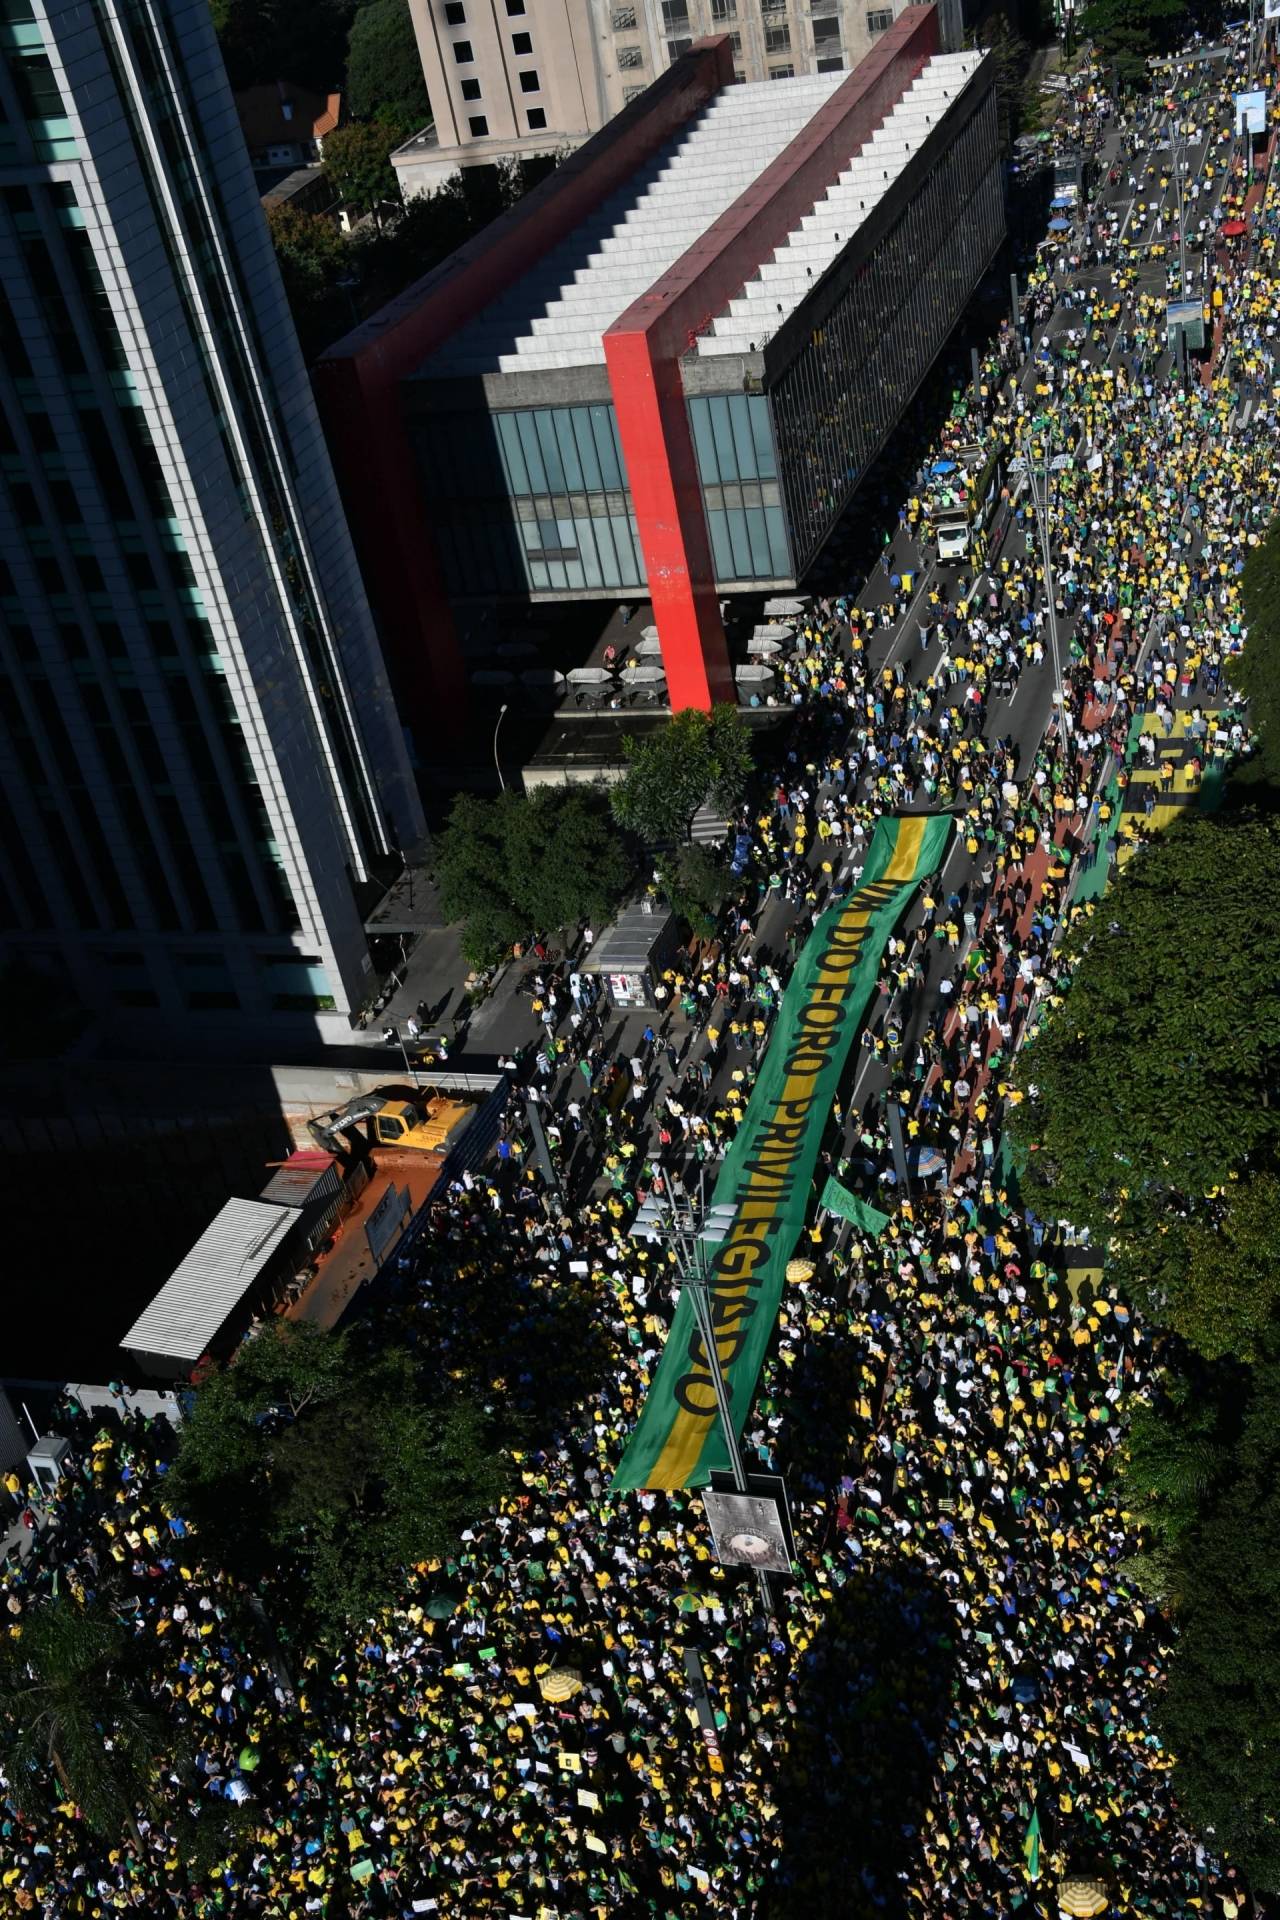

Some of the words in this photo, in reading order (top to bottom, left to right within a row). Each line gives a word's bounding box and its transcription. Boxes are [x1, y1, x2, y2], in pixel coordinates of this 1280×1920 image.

[815, 925, 873, 974] DO
[783, 981, 853, 1077] FORO
[674, 1093, 818, 1417] PRIVILEGIADO
